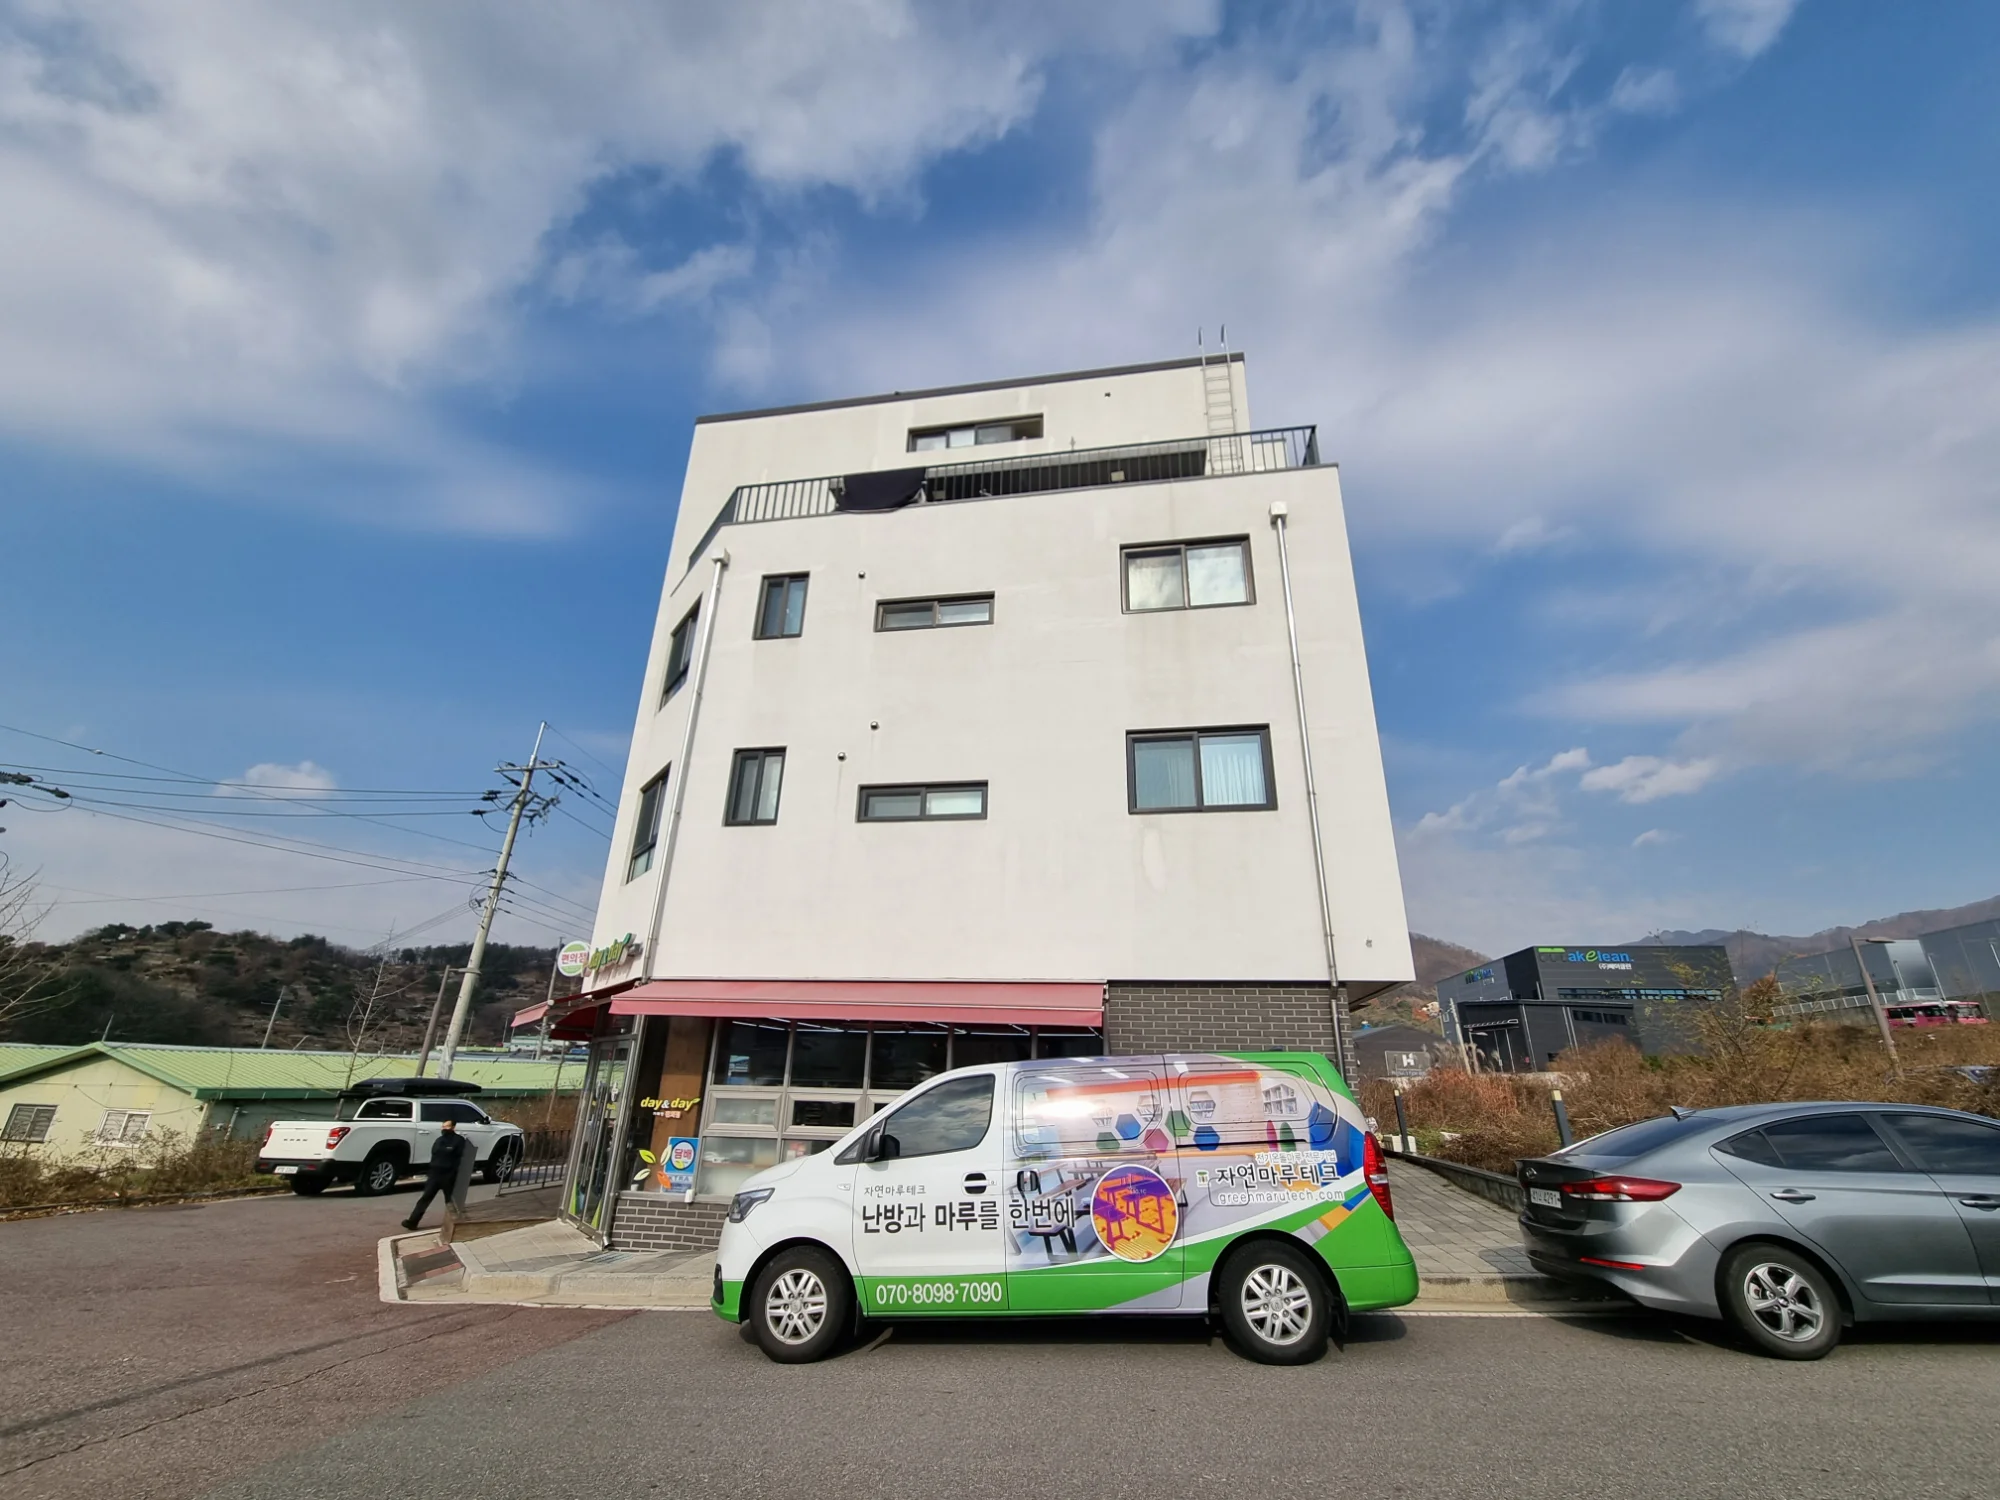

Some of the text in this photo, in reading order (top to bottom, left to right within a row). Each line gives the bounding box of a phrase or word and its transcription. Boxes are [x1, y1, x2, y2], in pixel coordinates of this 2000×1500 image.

[674, 1148, 692, 1160] 담배
[1216, 1164, 1340, 1188] 자연마루테크
[864, 1184, 926, 1197] 자연마루테크
[1219, 1189, 1345, 1204] greenmarutech.com
[862, 1197, 1075, 1233] 난방과 마루를 한번에
